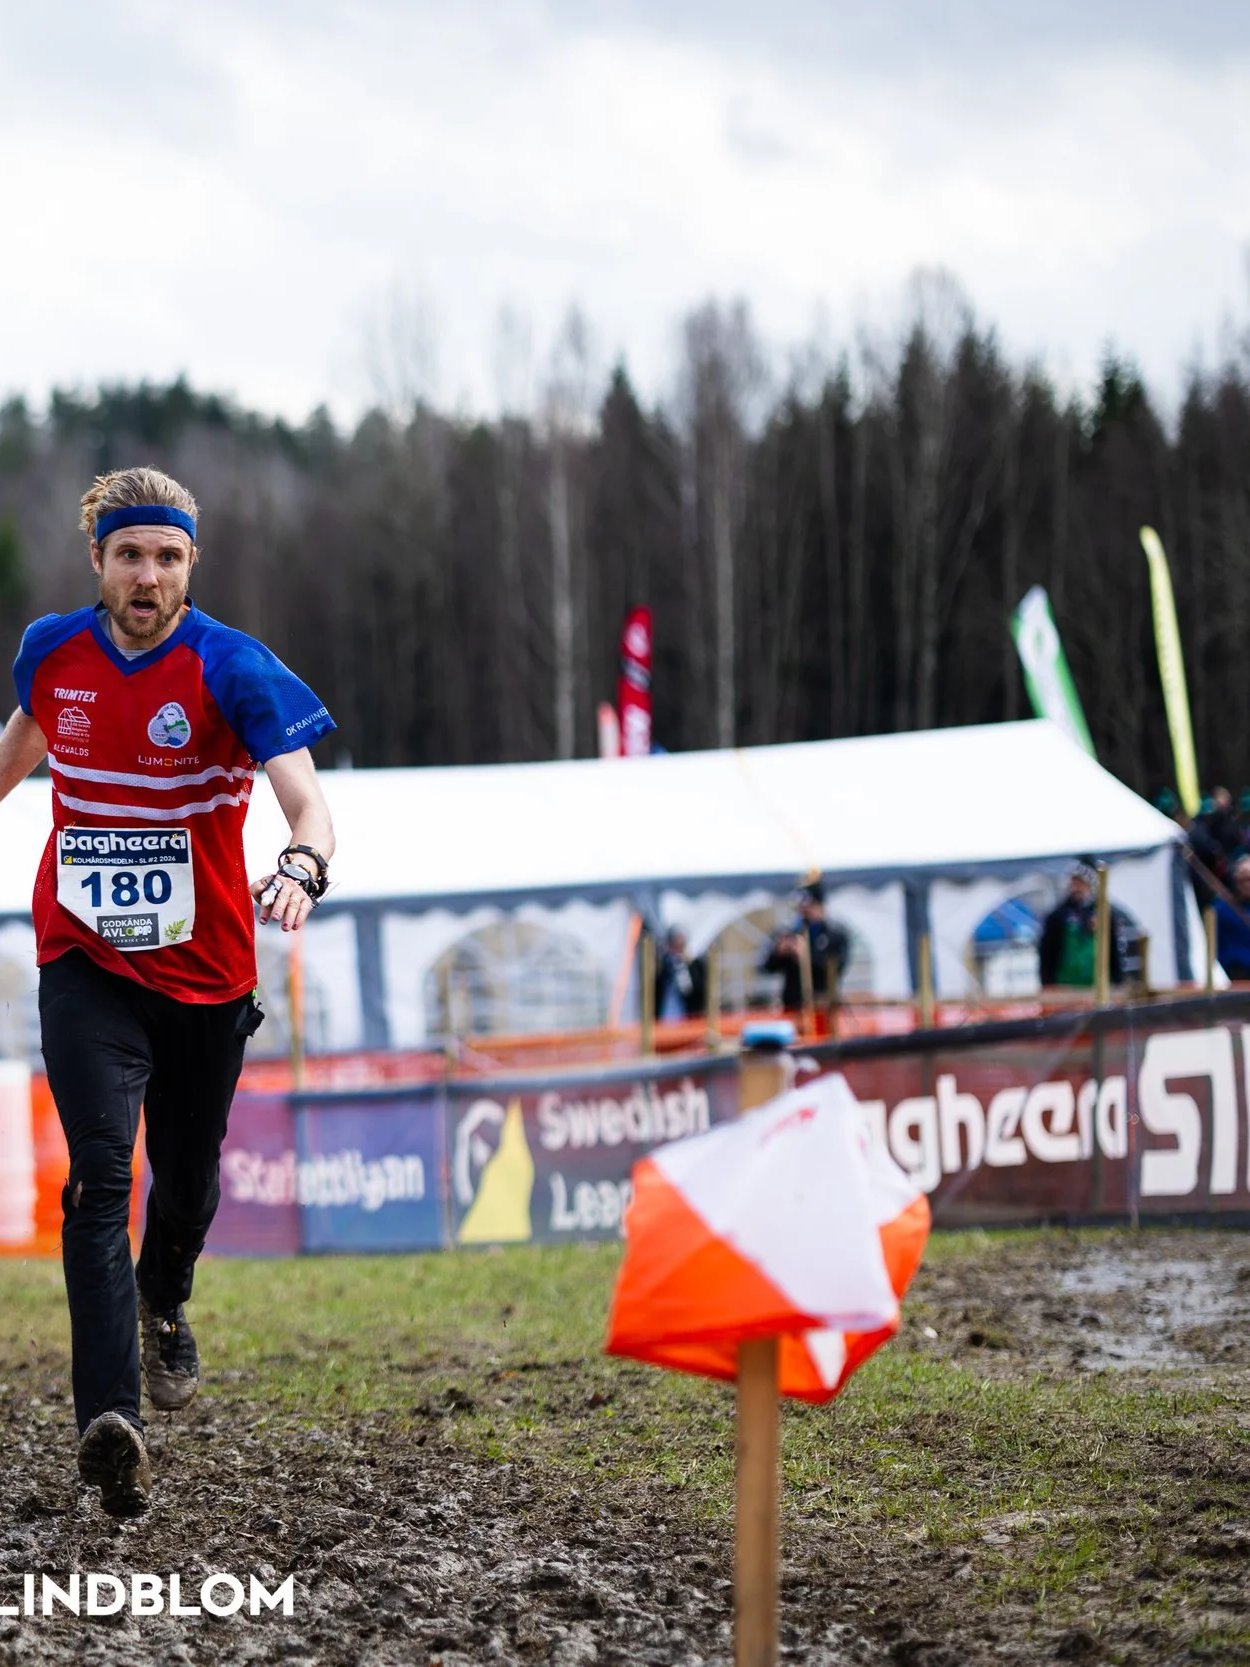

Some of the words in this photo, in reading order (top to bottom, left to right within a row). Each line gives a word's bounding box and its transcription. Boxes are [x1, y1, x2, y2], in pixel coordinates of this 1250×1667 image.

[53, 687, 98, 703] TRIMTEX
[285, 724, 297, 736] OK
[53, 743, 90, 757] ALEWALDS
[137, 754, 200, 767] LUMONITE
[60, 831, 187, 854] bagheera
[72, 855, 134, 865] KOLMÅRDSMEDELN
[81, 869, 173, 908] 180
[102, 917, 153, 928] GODKÄNDA
[537, 1075, 711, 1151] Swedish
[224, 1147, 426, 1211] Stafettligan
